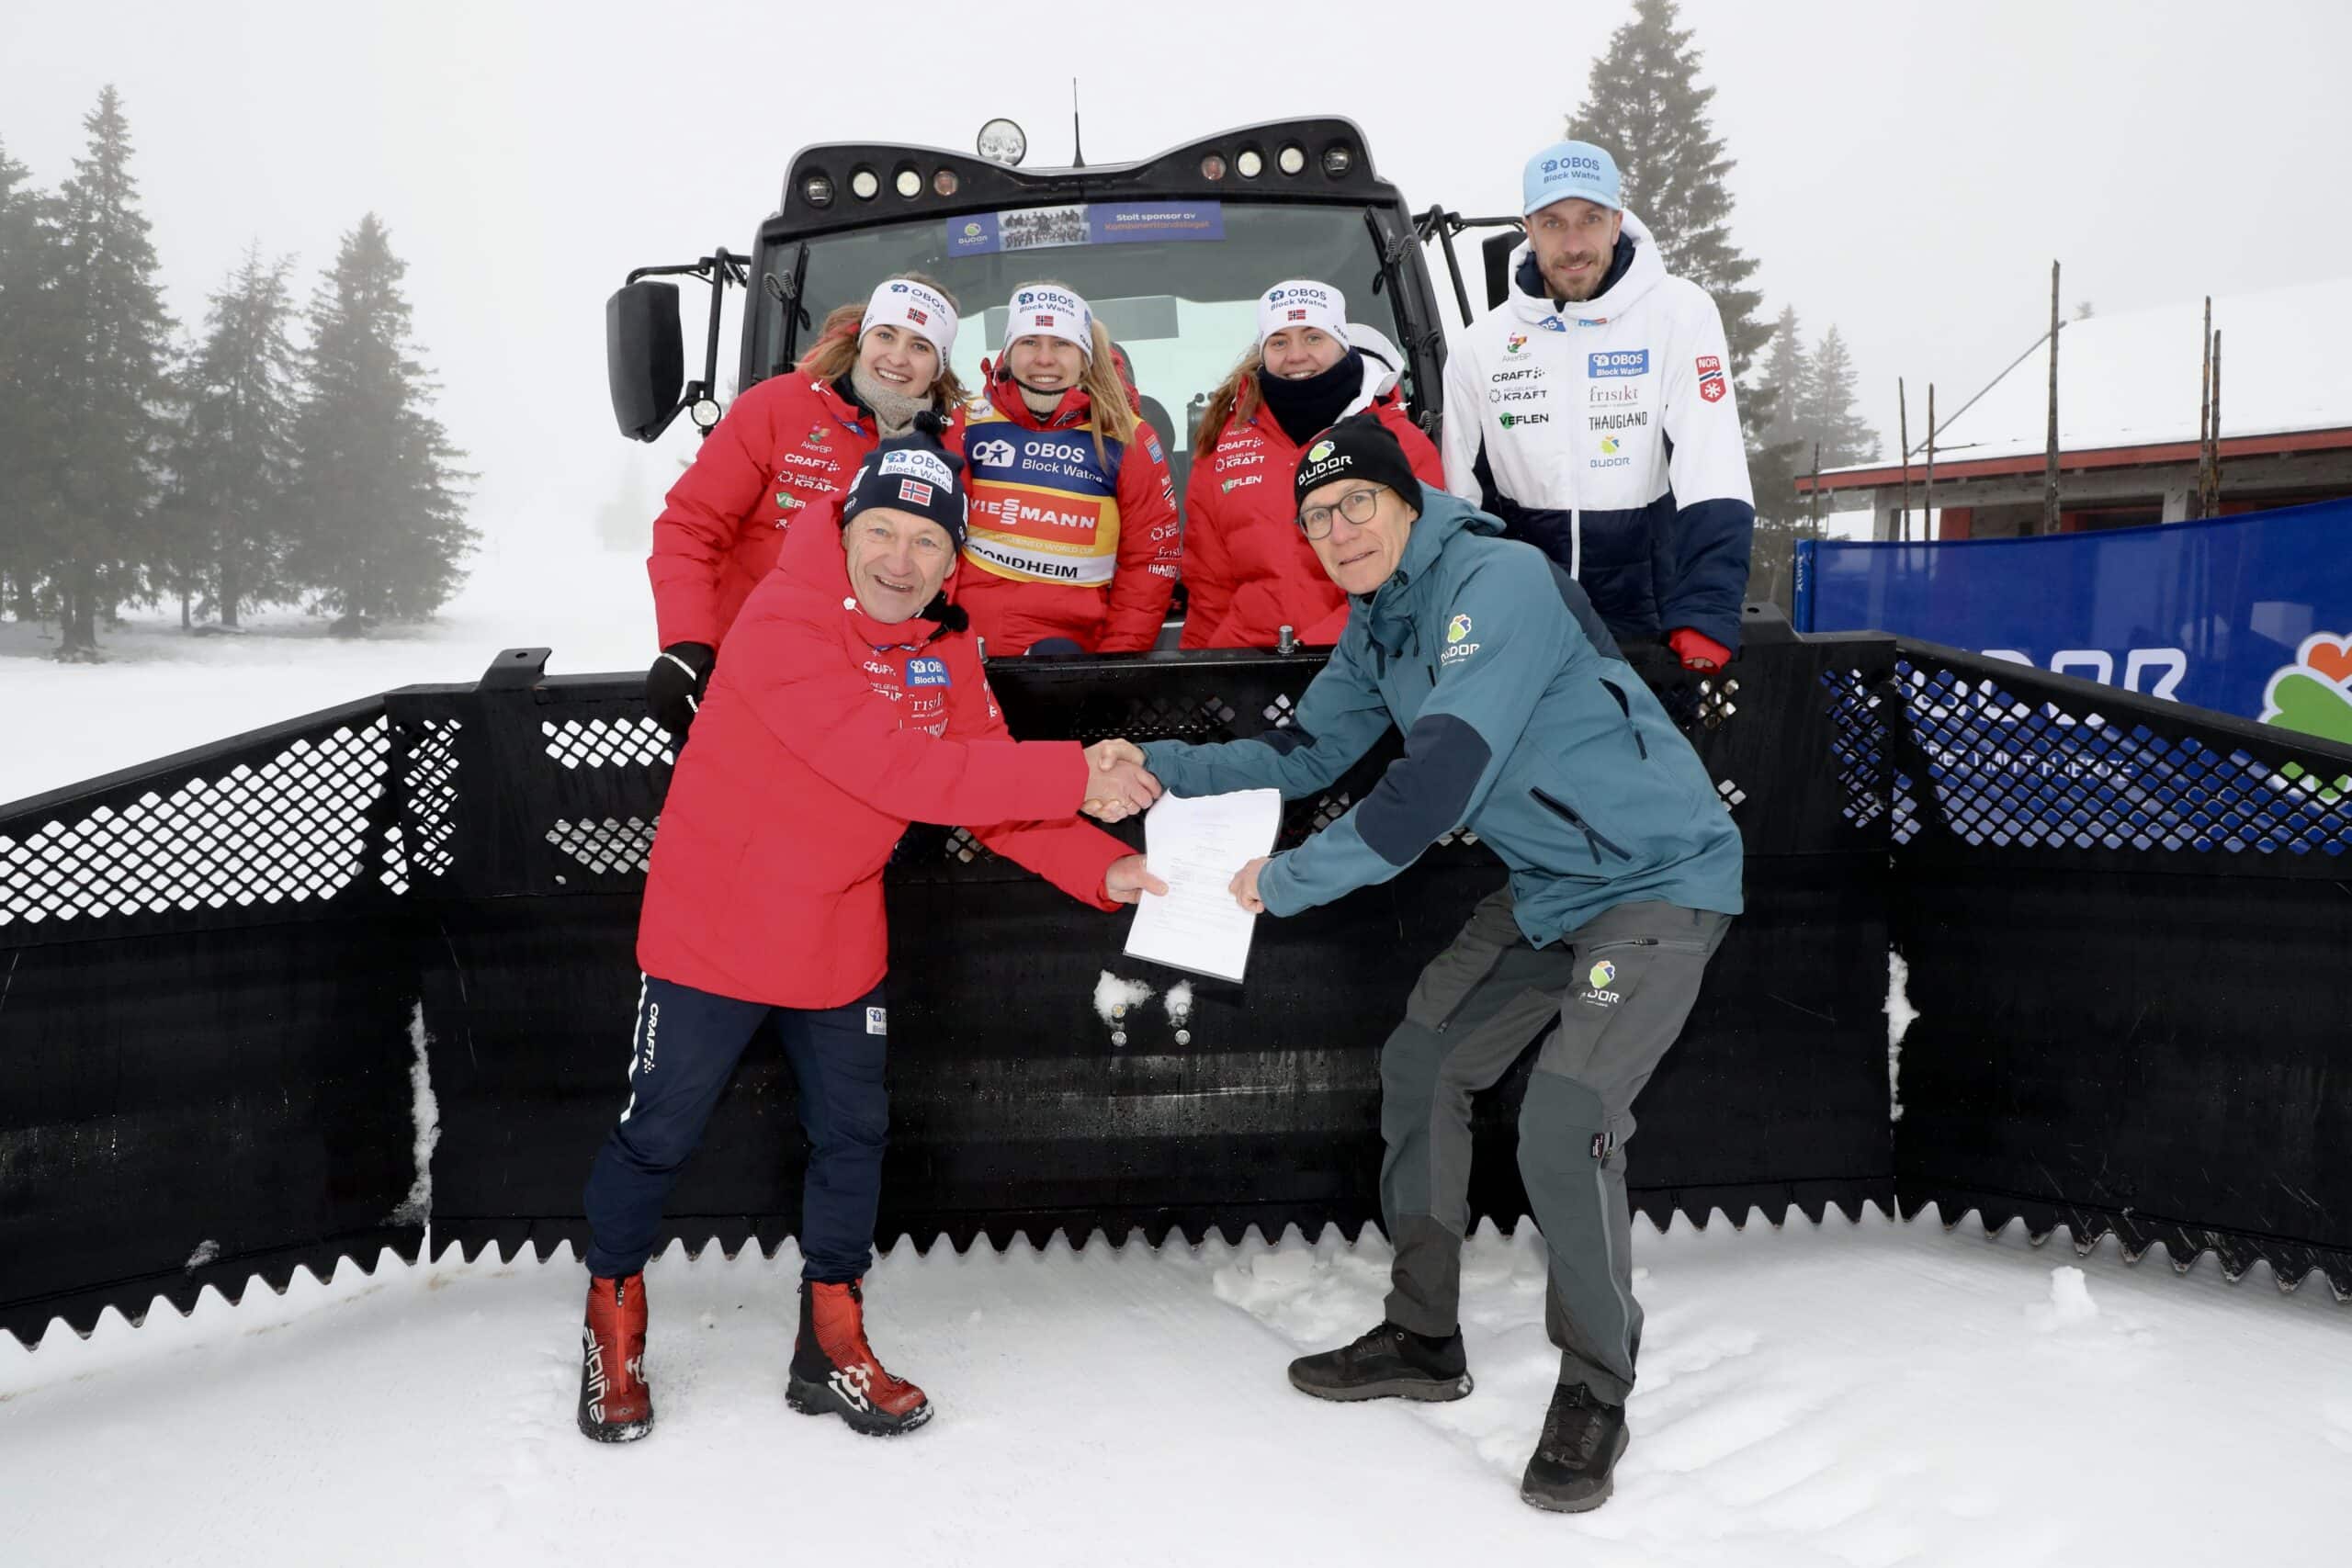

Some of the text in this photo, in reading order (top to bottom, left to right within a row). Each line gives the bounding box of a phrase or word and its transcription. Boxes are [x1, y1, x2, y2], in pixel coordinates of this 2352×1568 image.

[1560, 157, 1600, 171] OBOS
[1544, 171, 1569, 184] Block
[1116, 213, 1139, 221] Stolt
[1141, 212, 1182, 221] sponsor
[1036, 292, 1074, 309] OBOS
[1287, 288, 1327, 300] OBOS
[910, 288, 945, 314] OBOS
[1271, 298, 1328, 310] Block Watne
[1019, 302, 1075, 317] Block Watne
[1611, 354, 1643, 366] OBOS
[1698, 357, 1718, 368] NOR
[1492, 369, 1532, 382] CRAFT
[1596, 367, 1643, 376] Block Watne
[1504, 390, 1546, 401] KRAFT
[1499, 413, 1549, 426] VEFLEN
[1589, 412, 1647, 430] THAUGLAND
[1216, 439, 1253, 452] CRAFT
[1024, 442, 1085, 463] OBOS
[785, 453, 829, 468] CRAFT
[1227, 456, 1264, 468] KRAFT
[1590, 457, 1630, 468] BUDOR
[886, 465, 916, 475] Block
[911, 455, 951, 481] OBOS
[1023, 459, 1102, 483] Block Watne
[1298, 456, 1352, 486] BUDOR
[794, 478, 840, 492] KRAFT
[1221, 474, 1262, 493] VEFLEN
[967, 544, 1078, 579] ONDHEIM
[914, 675, 935, 684] Block
[644, 1002, 659, 1060] CRAFT
[584, 1326, 611, 1425] alpine
